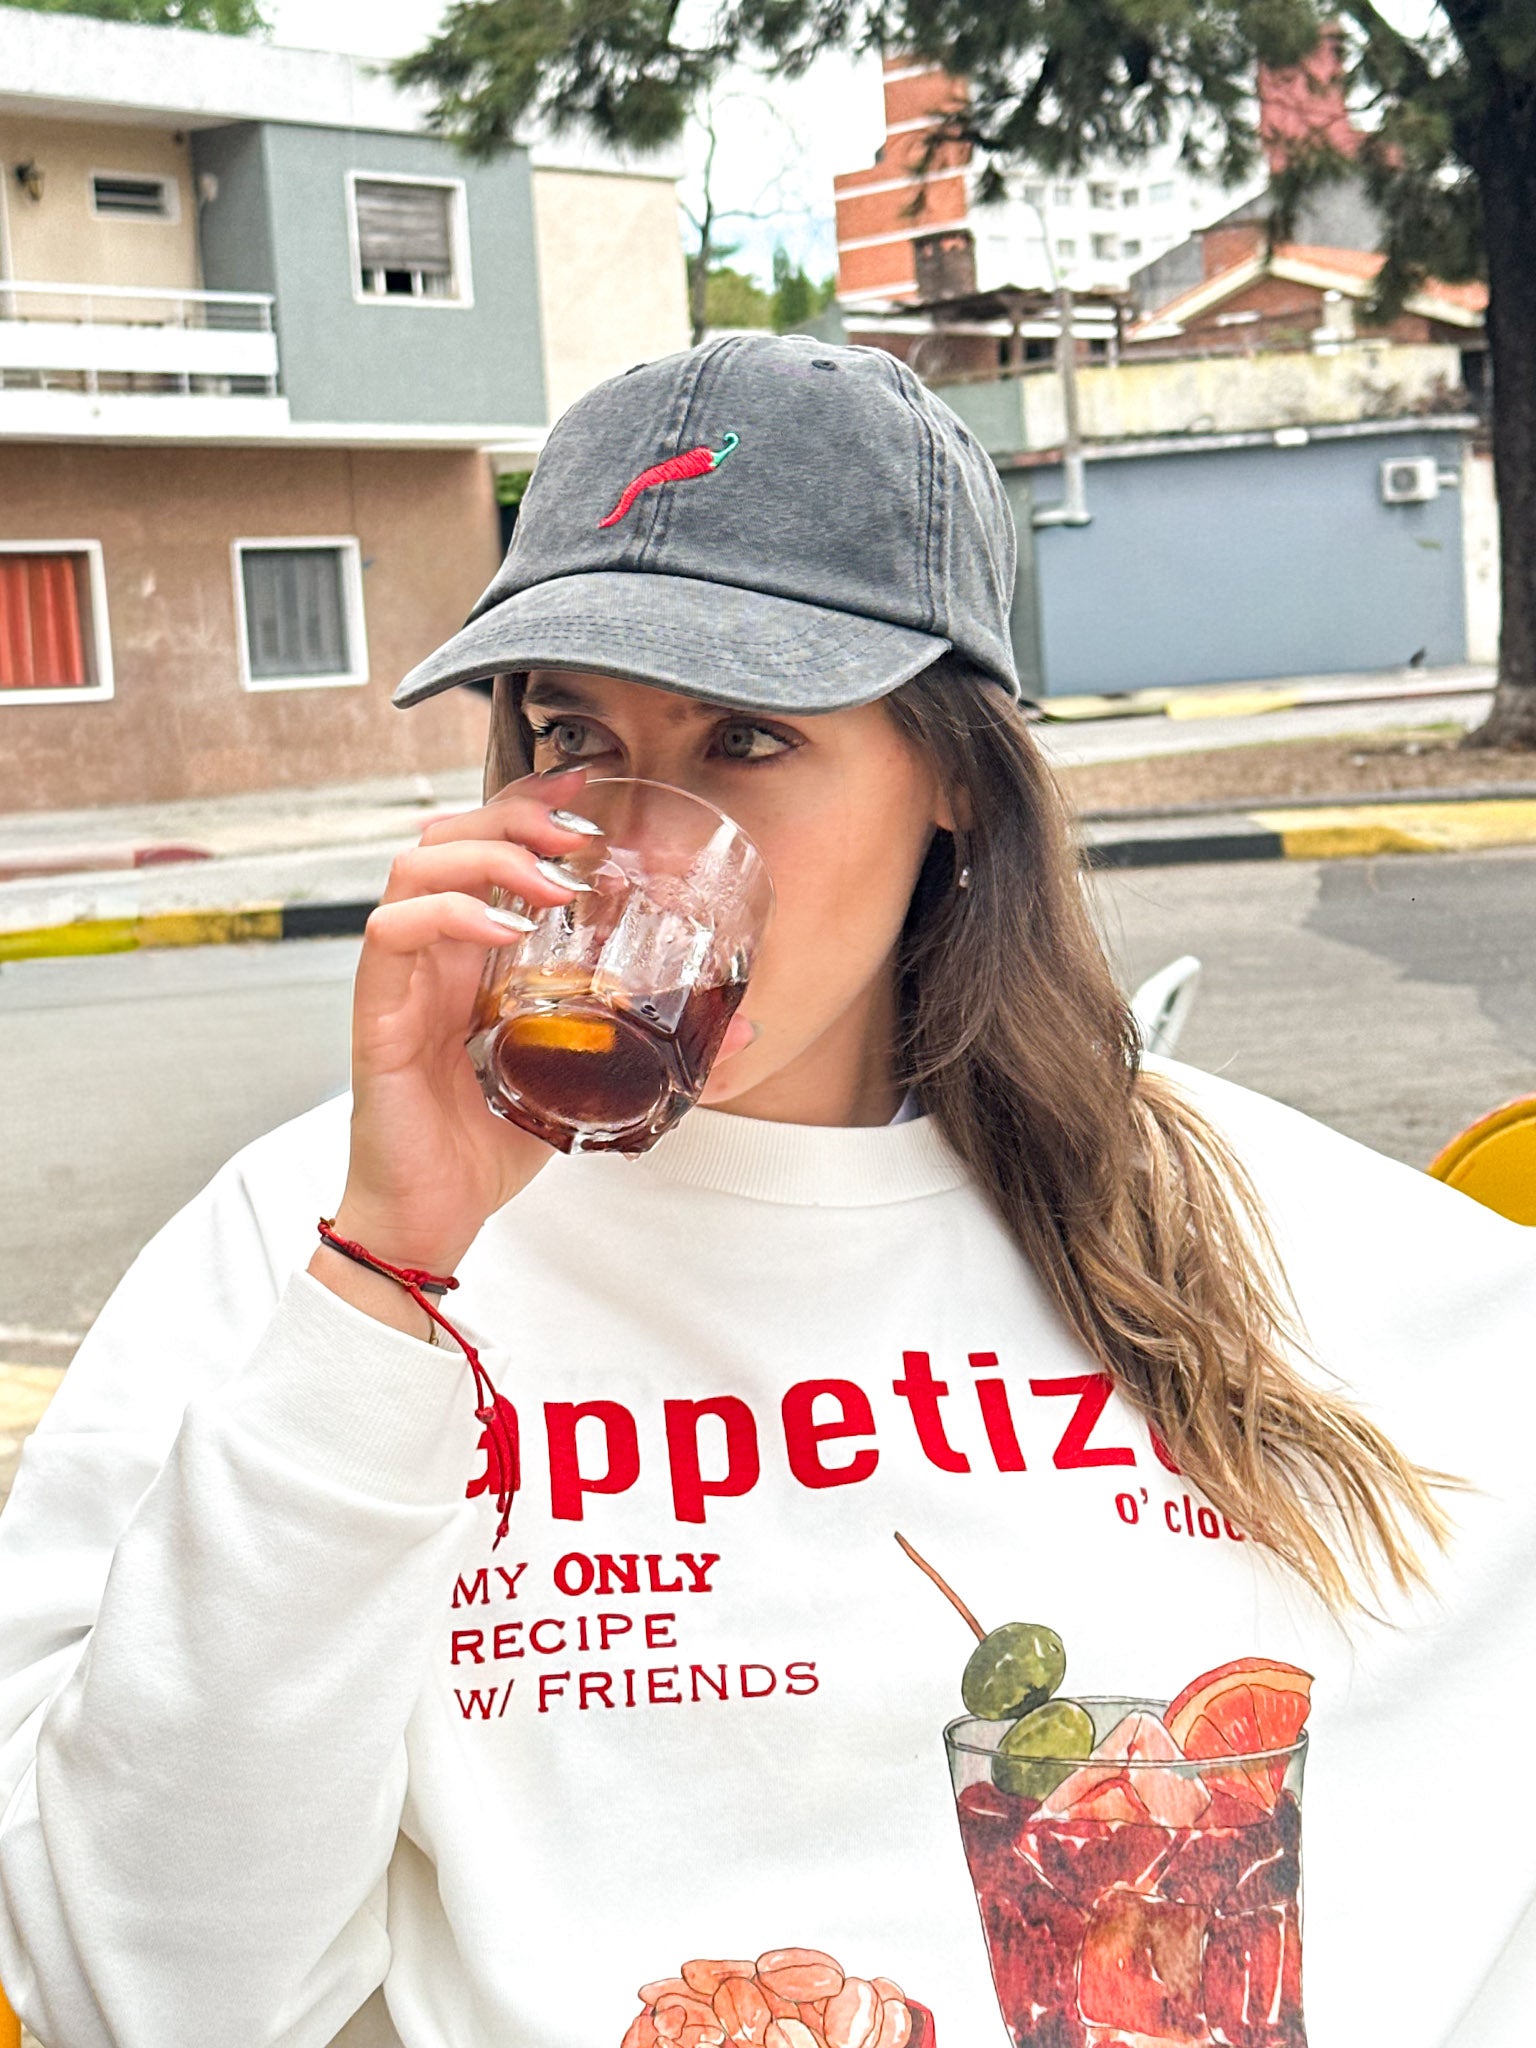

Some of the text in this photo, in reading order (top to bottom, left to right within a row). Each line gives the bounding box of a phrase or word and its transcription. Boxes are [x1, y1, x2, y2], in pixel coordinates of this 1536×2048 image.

[466, 1350, 1184, 1524] appetiz
[451, 1552, 721, 1609] MY ONLY
[450, 1612, 678, 1666] RECIPE
[453, 1661, 821, 1721] W/ FRIENDS
